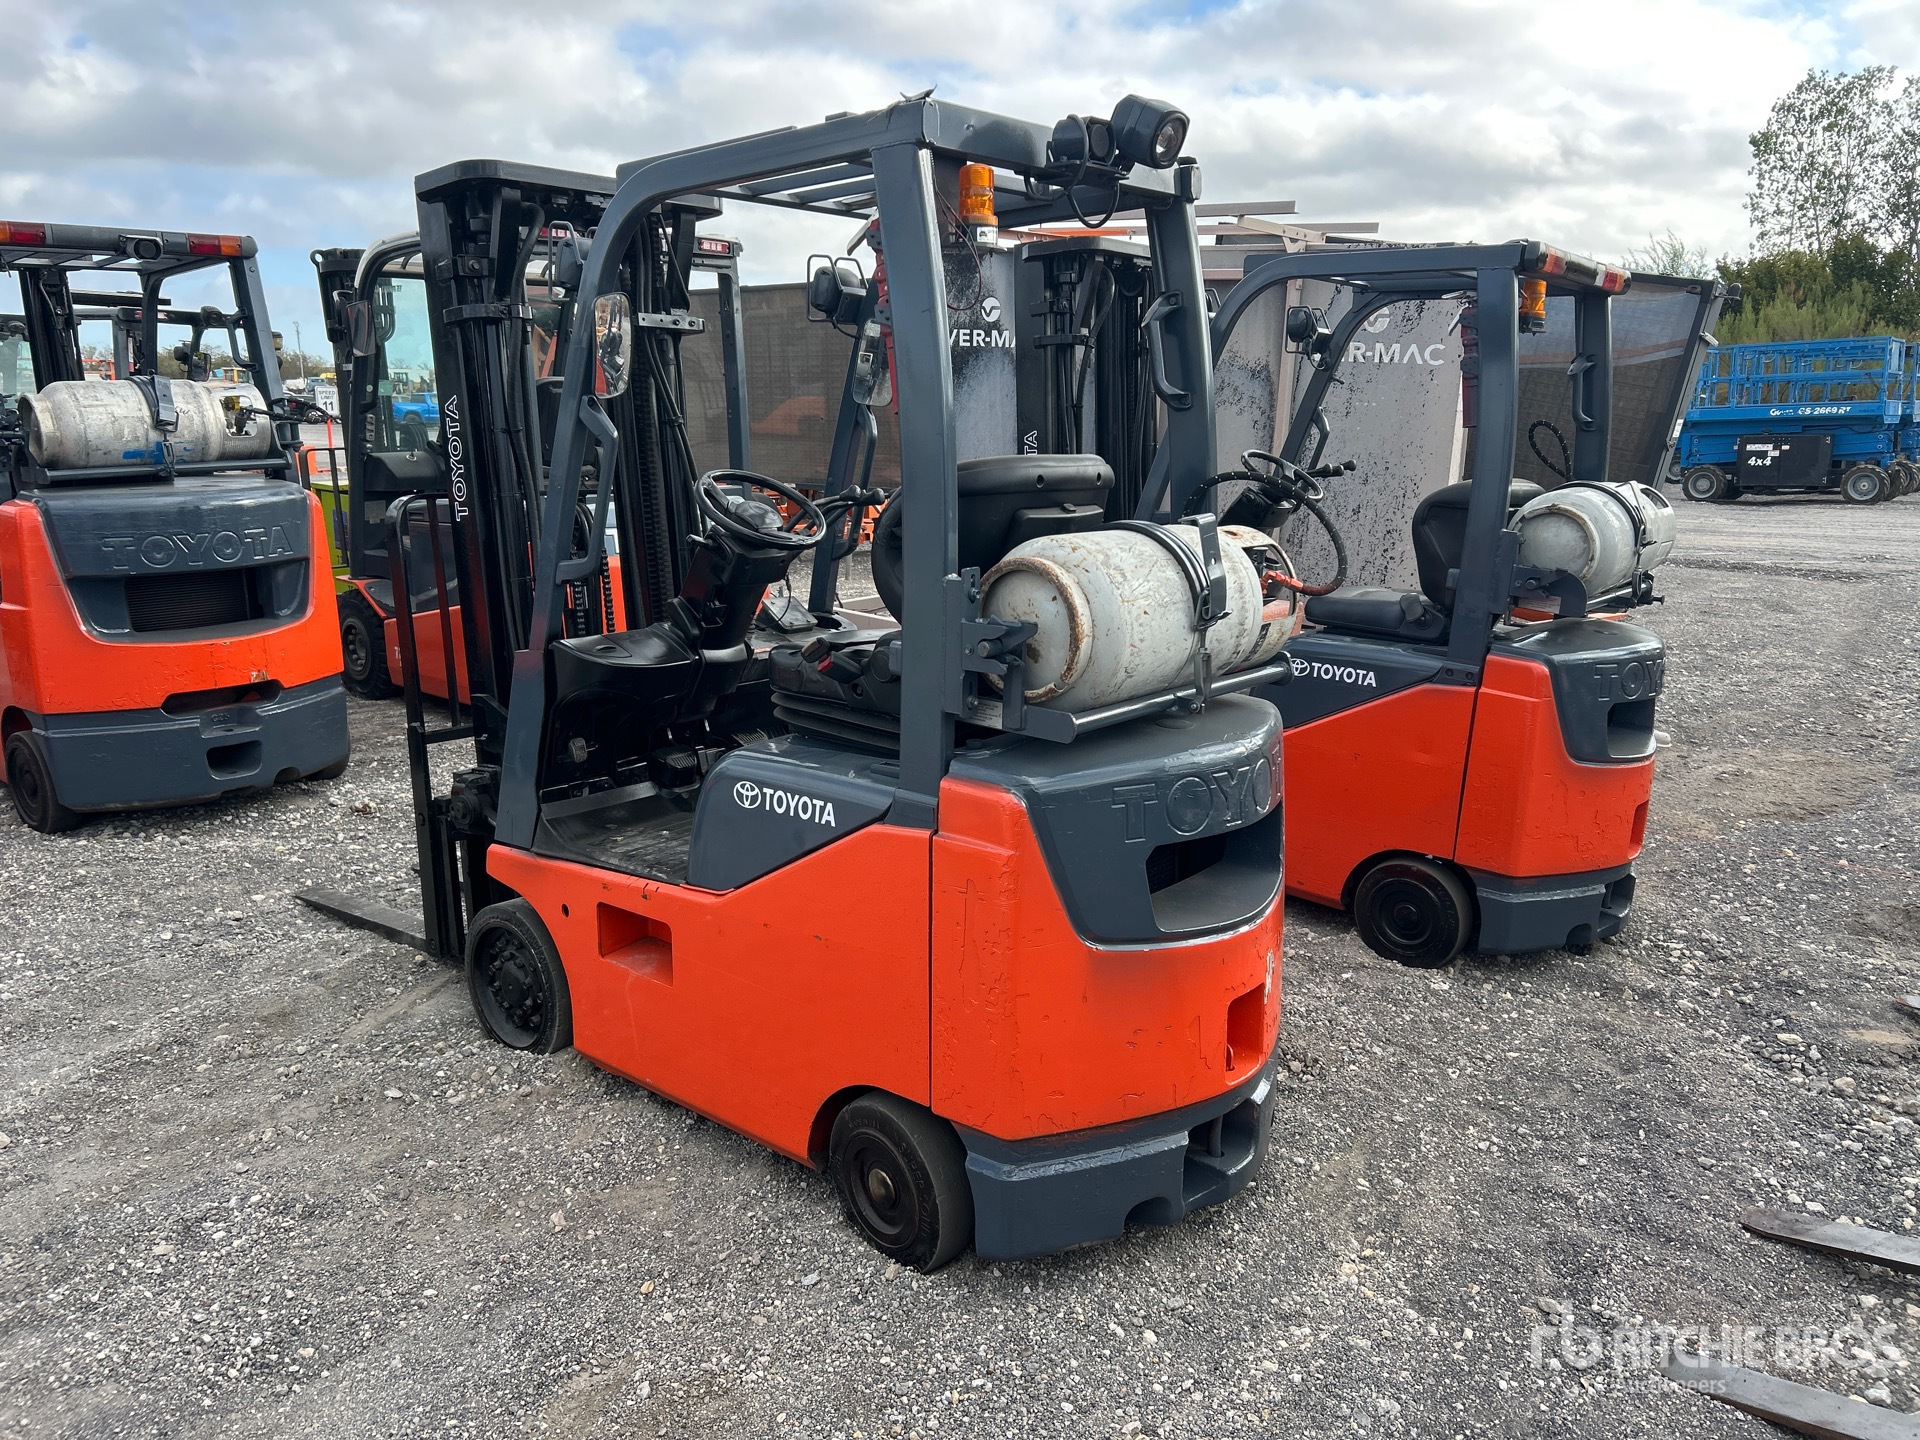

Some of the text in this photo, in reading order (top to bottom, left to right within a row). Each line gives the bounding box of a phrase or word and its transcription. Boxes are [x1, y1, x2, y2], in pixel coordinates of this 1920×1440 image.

[949, 329, 1015, 348] VER-M
[1341, 341, 1446, 366] R-MAC
[322, 400, 334, 411] 11
[445, 395, 468, 521] TOYOTA
[1747, 456, 1772, 466] 4x4
[101, 532, 294, 570] TOYOTA
[1311, 662, 1377, 687] TOYOTA
[1593, 657, 1665, 701] TOY
[762, 787, 836, 828] TOYOTA
